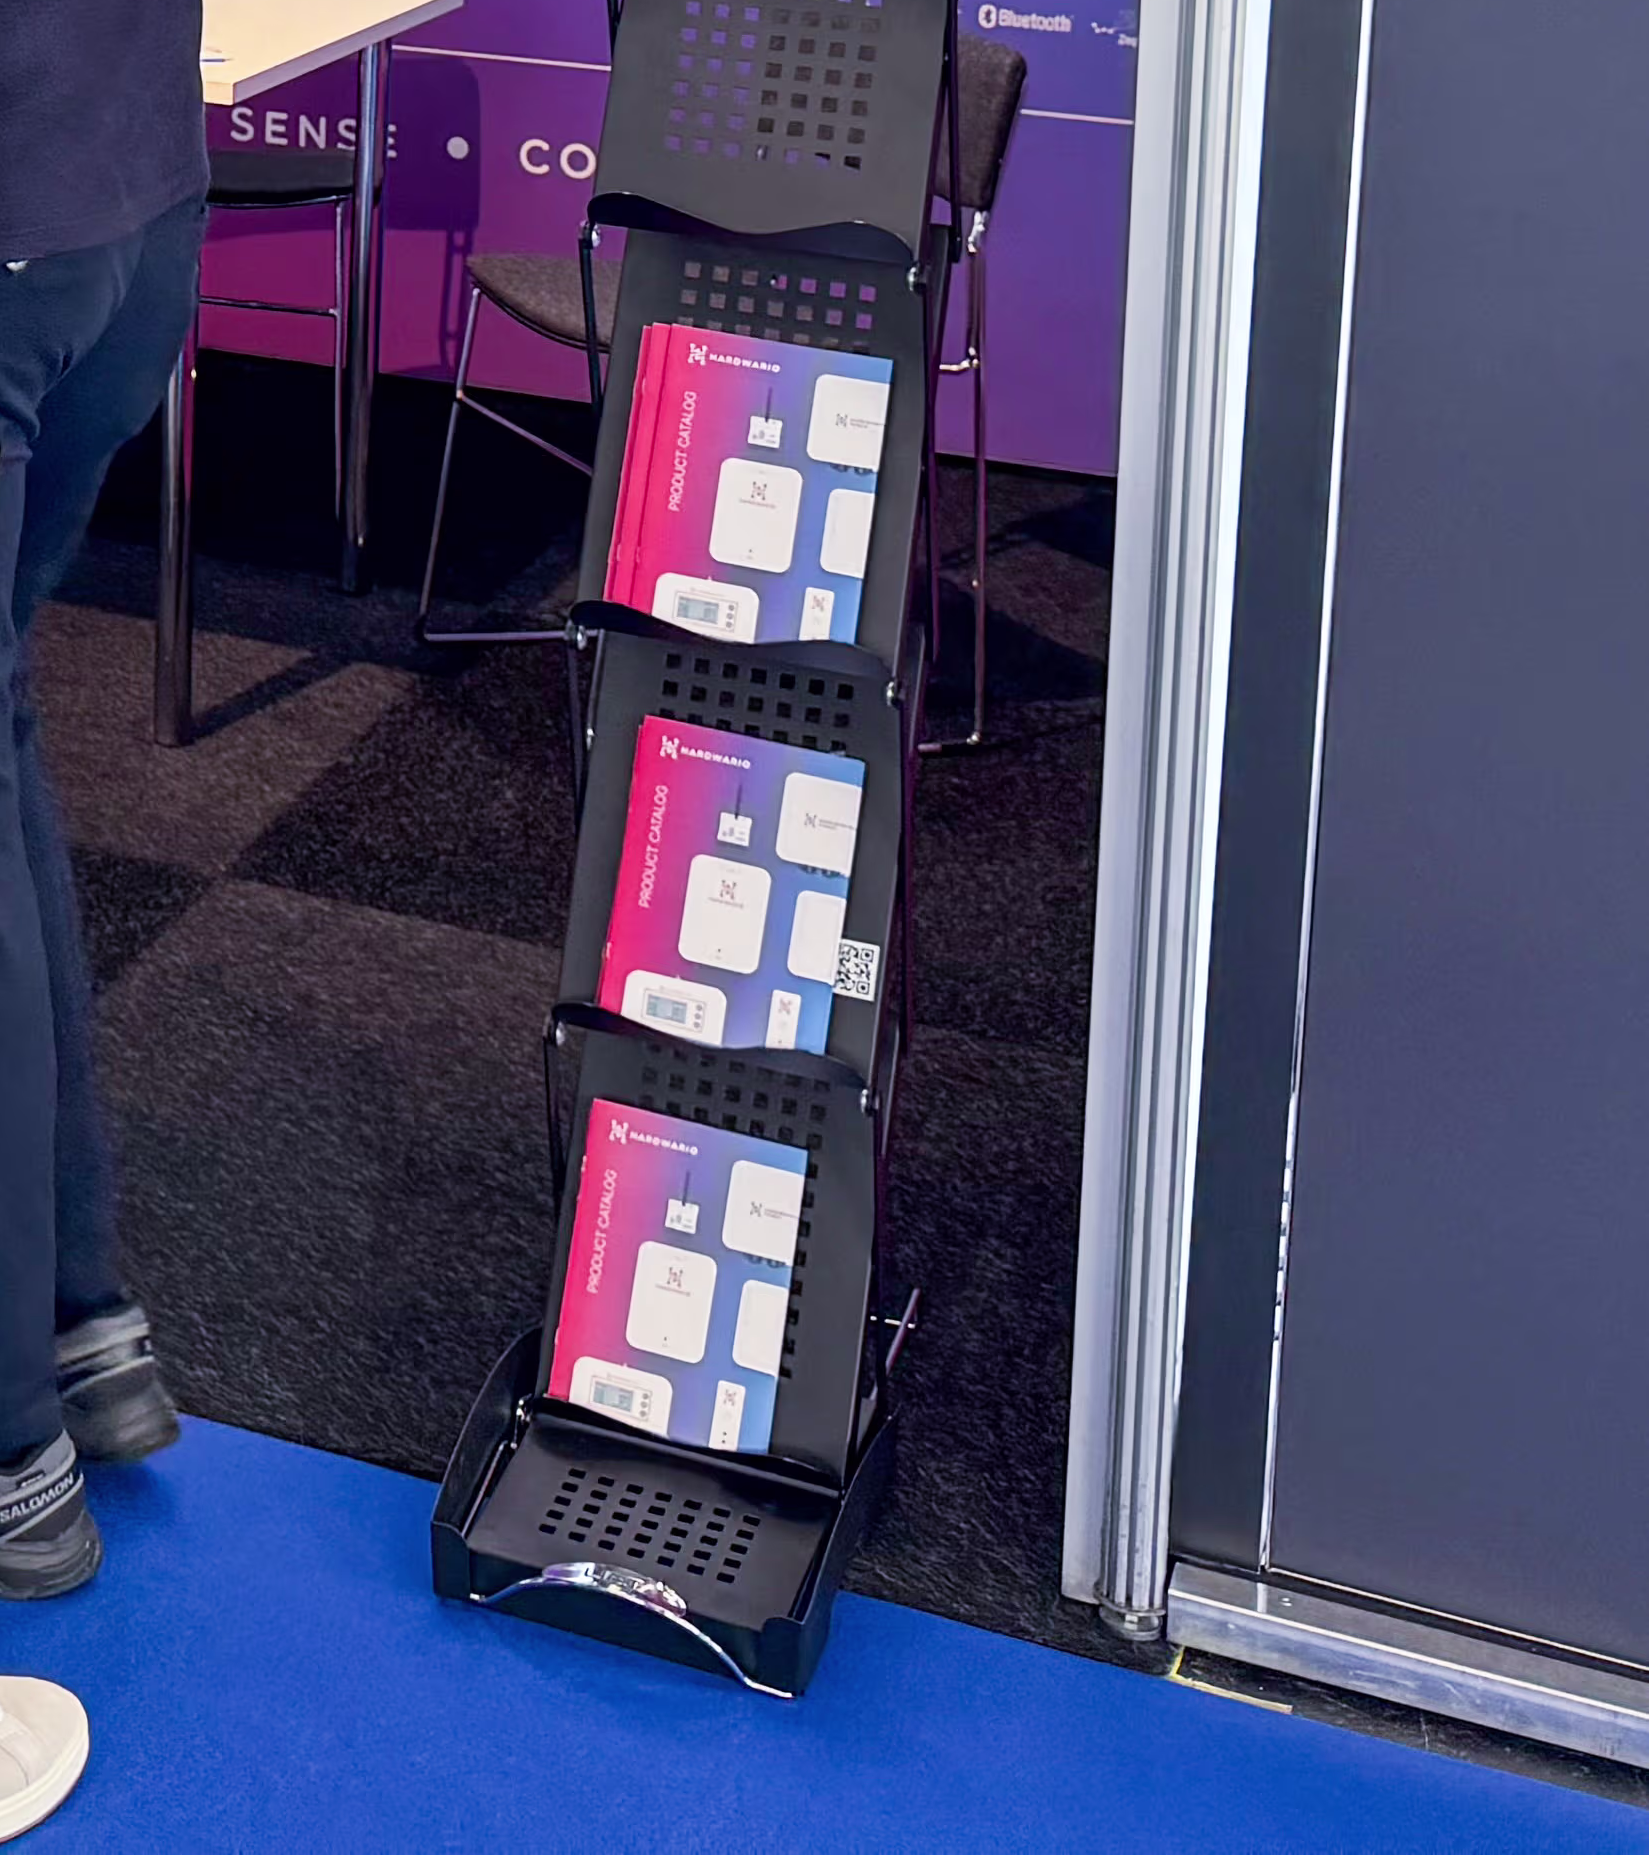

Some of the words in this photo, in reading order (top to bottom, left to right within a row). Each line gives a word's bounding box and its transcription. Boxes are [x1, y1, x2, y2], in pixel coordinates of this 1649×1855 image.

[709, 353, 781, 373] HARDWARIO
[668, 449, 688, 512] PRODUCT
[678, 391, 697, 449] CATALOG
[680, 745, 751, 769] HARDWARIO
[648, 785, 669, 845] CATALOG
[638, 845, 659, 909] PRODUCT
[630, 1130, 698, 1155] HARDWARIO
[587, 1229, 607, 1294] PRODUCT
[597, 1169, 618, 1229] CATALOG
[0, 1472, 74, 1523] SALOMON
